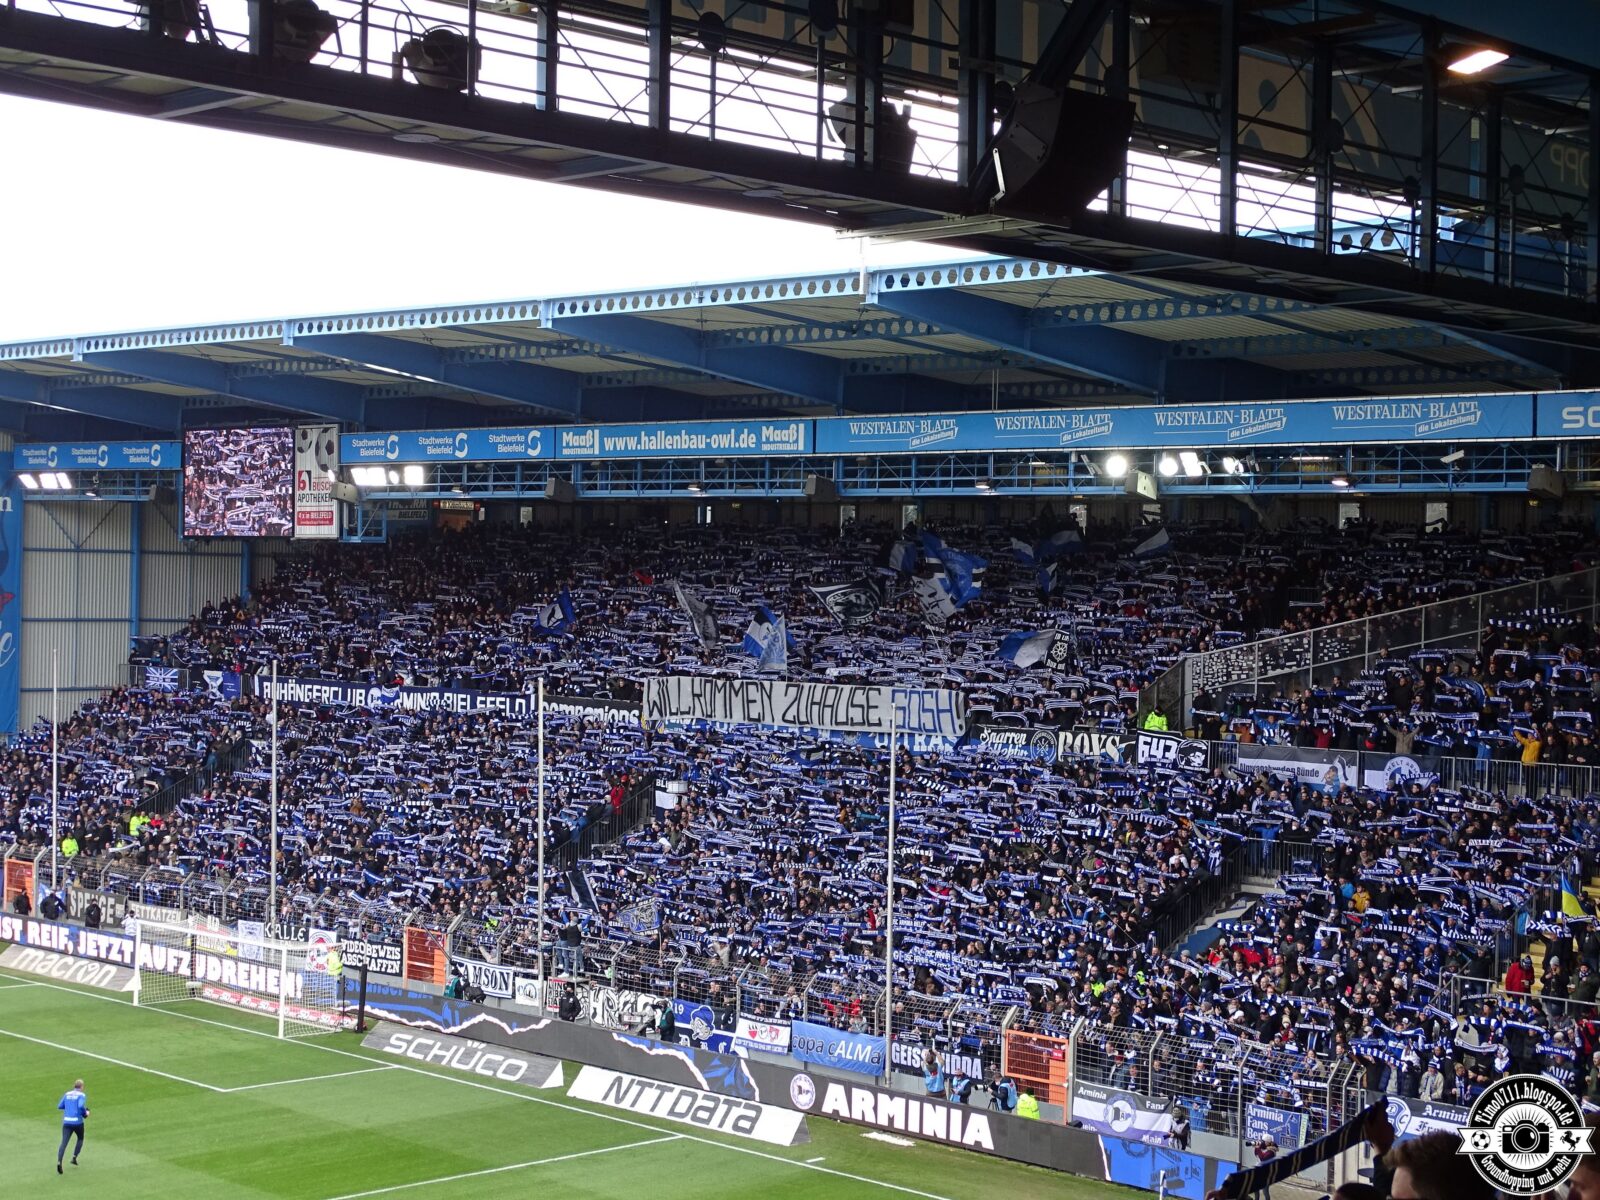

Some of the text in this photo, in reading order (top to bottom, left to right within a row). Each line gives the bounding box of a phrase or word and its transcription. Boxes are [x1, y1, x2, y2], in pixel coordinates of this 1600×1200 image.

[1154, 408, 1284, 426] WESTFALEN-BLATT
[1332, 401, 1478, 421] WESTFALEN-BLATT
[849, 419, 956, 435] WESTFALEN-BLATT
[994, 414, 1111, 431] WESTFALEN-BLATT
[1230, 418, 1282, 438] die Lokalzeitung
[1418, 412, 1476, 433] die Lokalzeitung
[418, 436, 453, 447] Stadtwerke
[488, 433, 525, 444] Stadtwerke
[562, 432, 594, 450] Maaß
[603, 432, 757, 452] www.hallenbau-owl.de
[761, 423, 797, 443] Maaß
[911, 430, 954, 447] die Lokalzeitung
[1062, 424, 1109, 442] die Lokalzeitung
[71, 447, 98, 457] Stadtwerke
[122, 446, 150, 456] Stadtwerke
[351, 438, 385, 448] Stadtwerke
[360, 447, 385, 457] Bielefeld
[426, 445, 453, 455] Bielefeld
[497, 442, 525, 453] Bielefeld
[21, 448, 48, 458] Stadtwerke
[28, 456, 48, 465] Bielefeld
[77, 455, 98, 464] Bielefeld
[128, 455, 150, 464] Bielefeld
[647, 677, 774, 722] WILLKOMMEN
[782, 683, 882, 727] ZUHAUSE
[1058, 731, 1120, 763] BOYS
[70, 890, 116, 924] SPEGE
[0, 915, 23, 942] ST
[27, 920, 74, 954] REIF,
[77, 931, 134, 964] JETZT
[264, 922, 305, 941] KALLE
[13, 948, 117, 986] macron
[462, 963, 510, 992] AMSON
[674, 1003, 684, 1015] 19
[792, 1035, 824, 1055] copa
[383, 1033, 529, 1082] SCHÜCO
[1077, 1086, 1165, 1111] Arminia Fans
[821, 1083, 995, 1151] ARMINIA
[1247, 1104, 1284, 1123] Arminia
[1247, 1116, 1269, 1131] Fans
